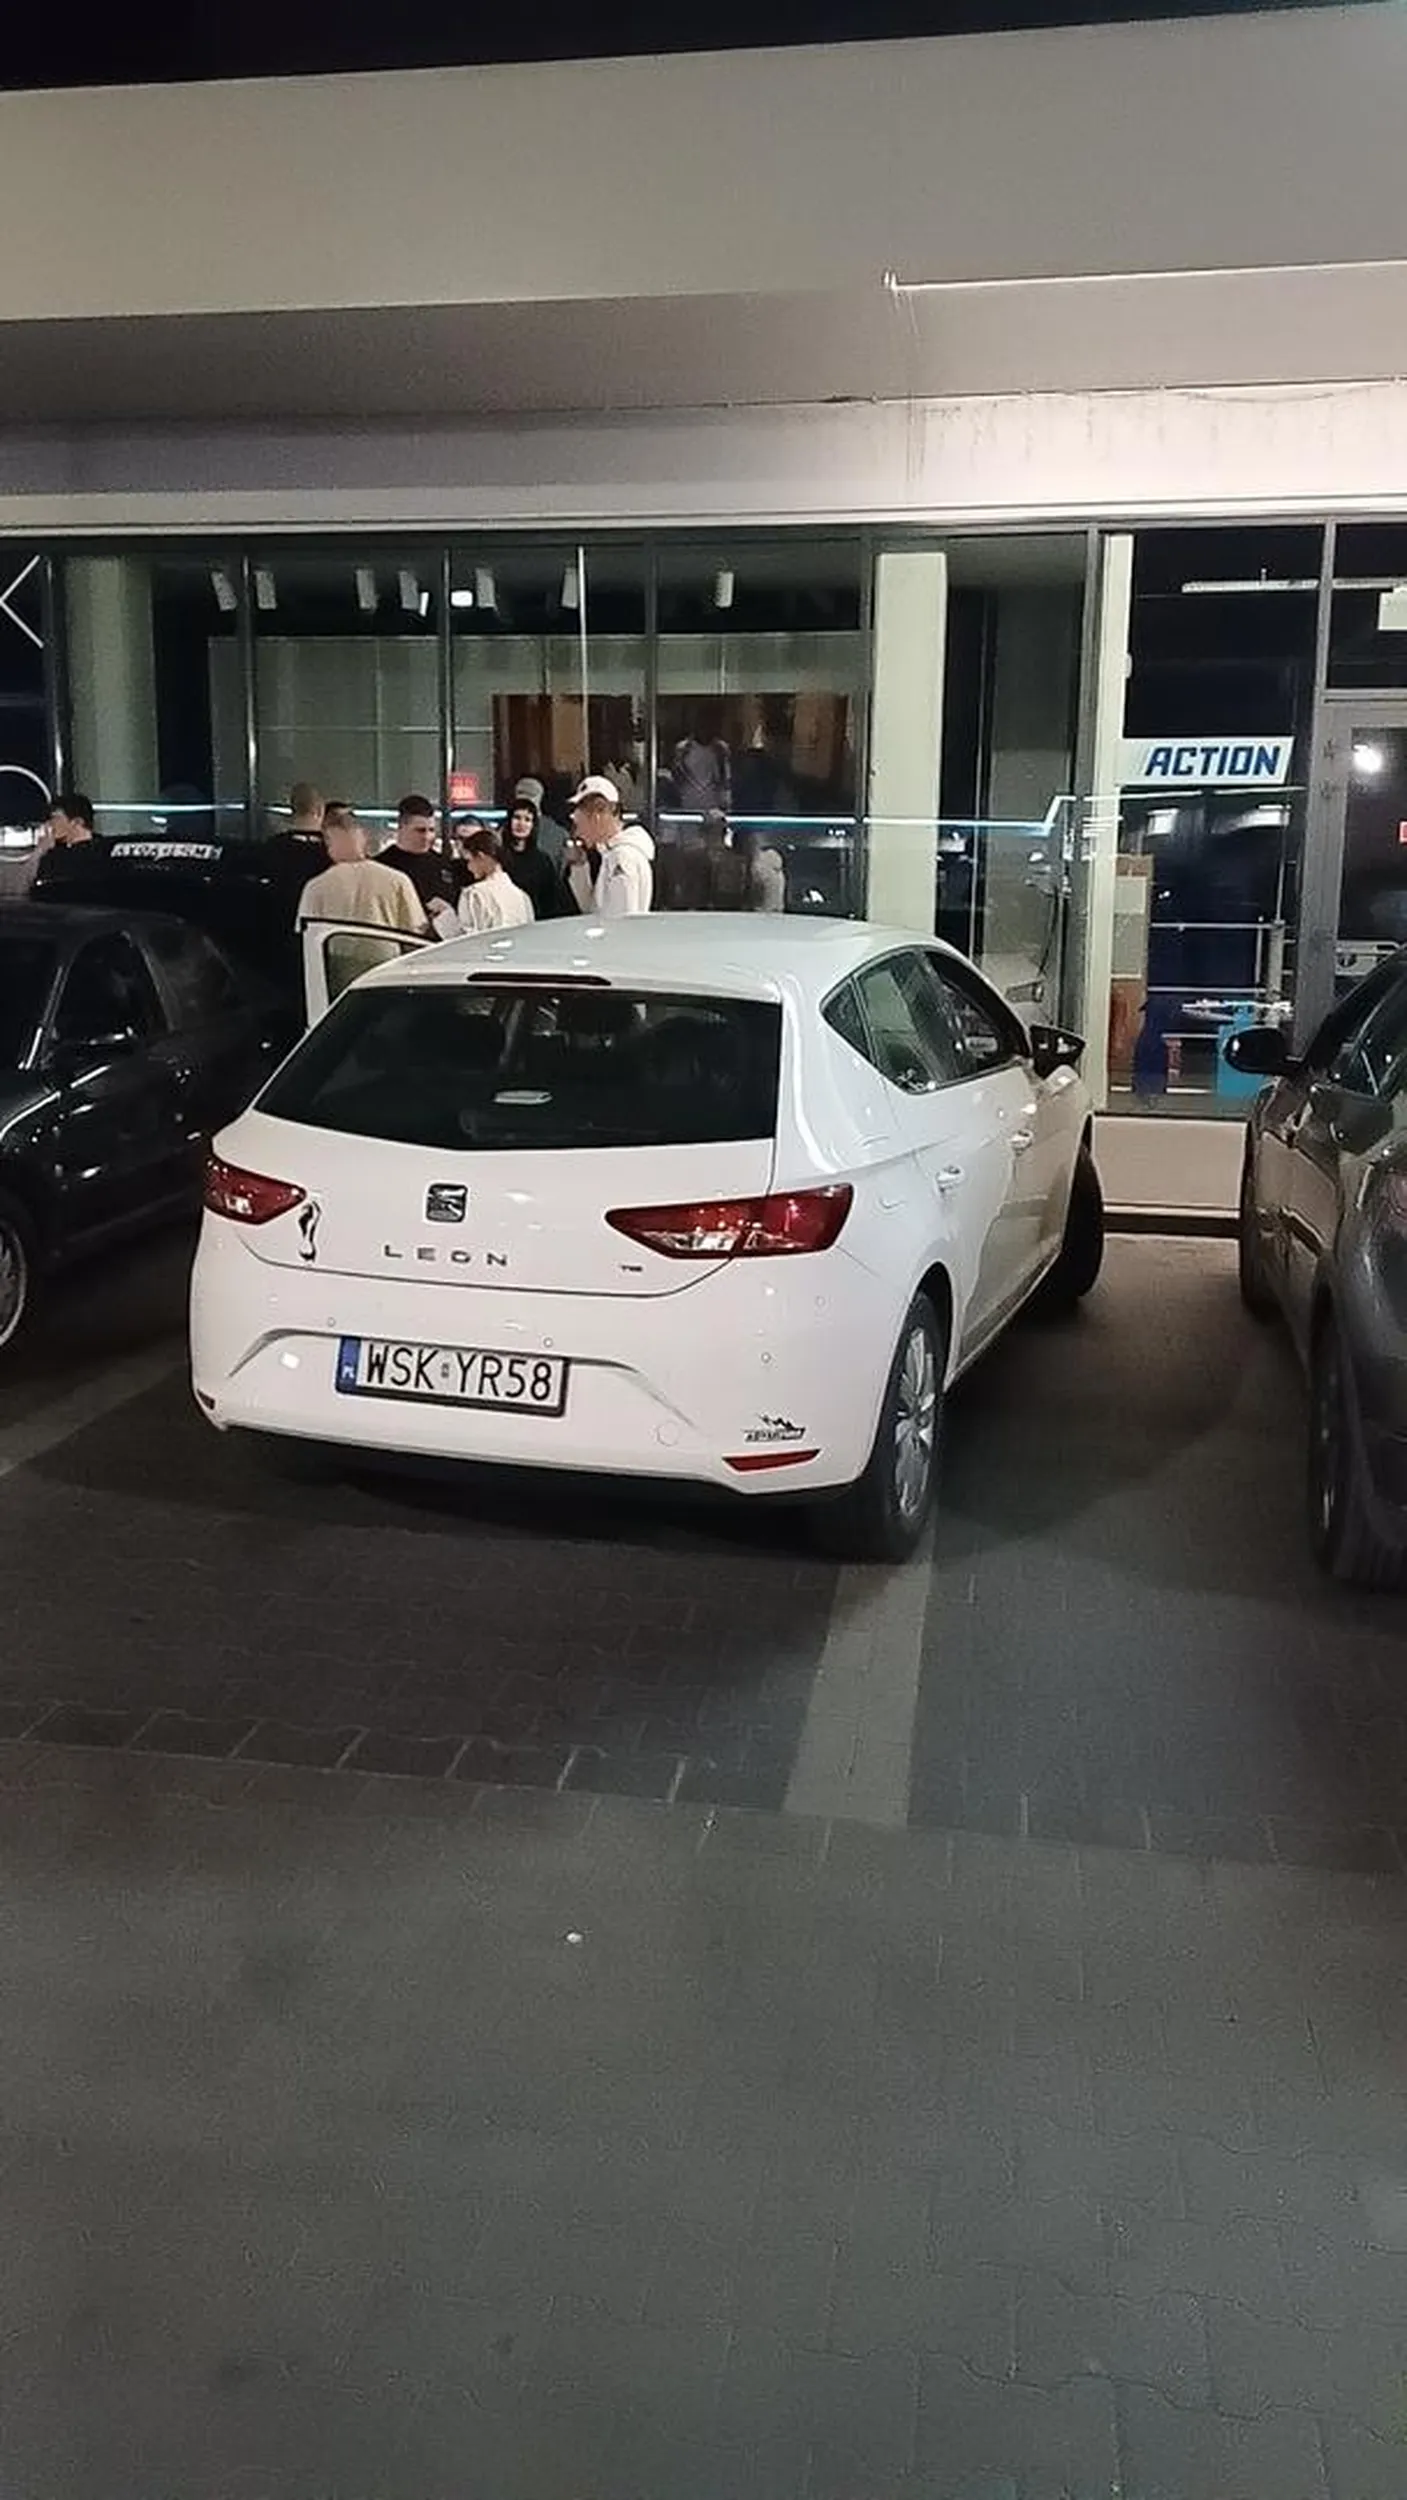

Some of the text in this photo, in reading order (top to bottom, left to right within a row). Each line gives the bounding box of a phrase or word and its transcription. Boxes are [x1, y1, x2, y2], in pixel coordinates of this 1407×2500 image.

[1144, 745, 1281, 776] ACTION
[384, 1244, 507, 1266] LEON
[366, 1343, 552, 1401] WSK YR58
